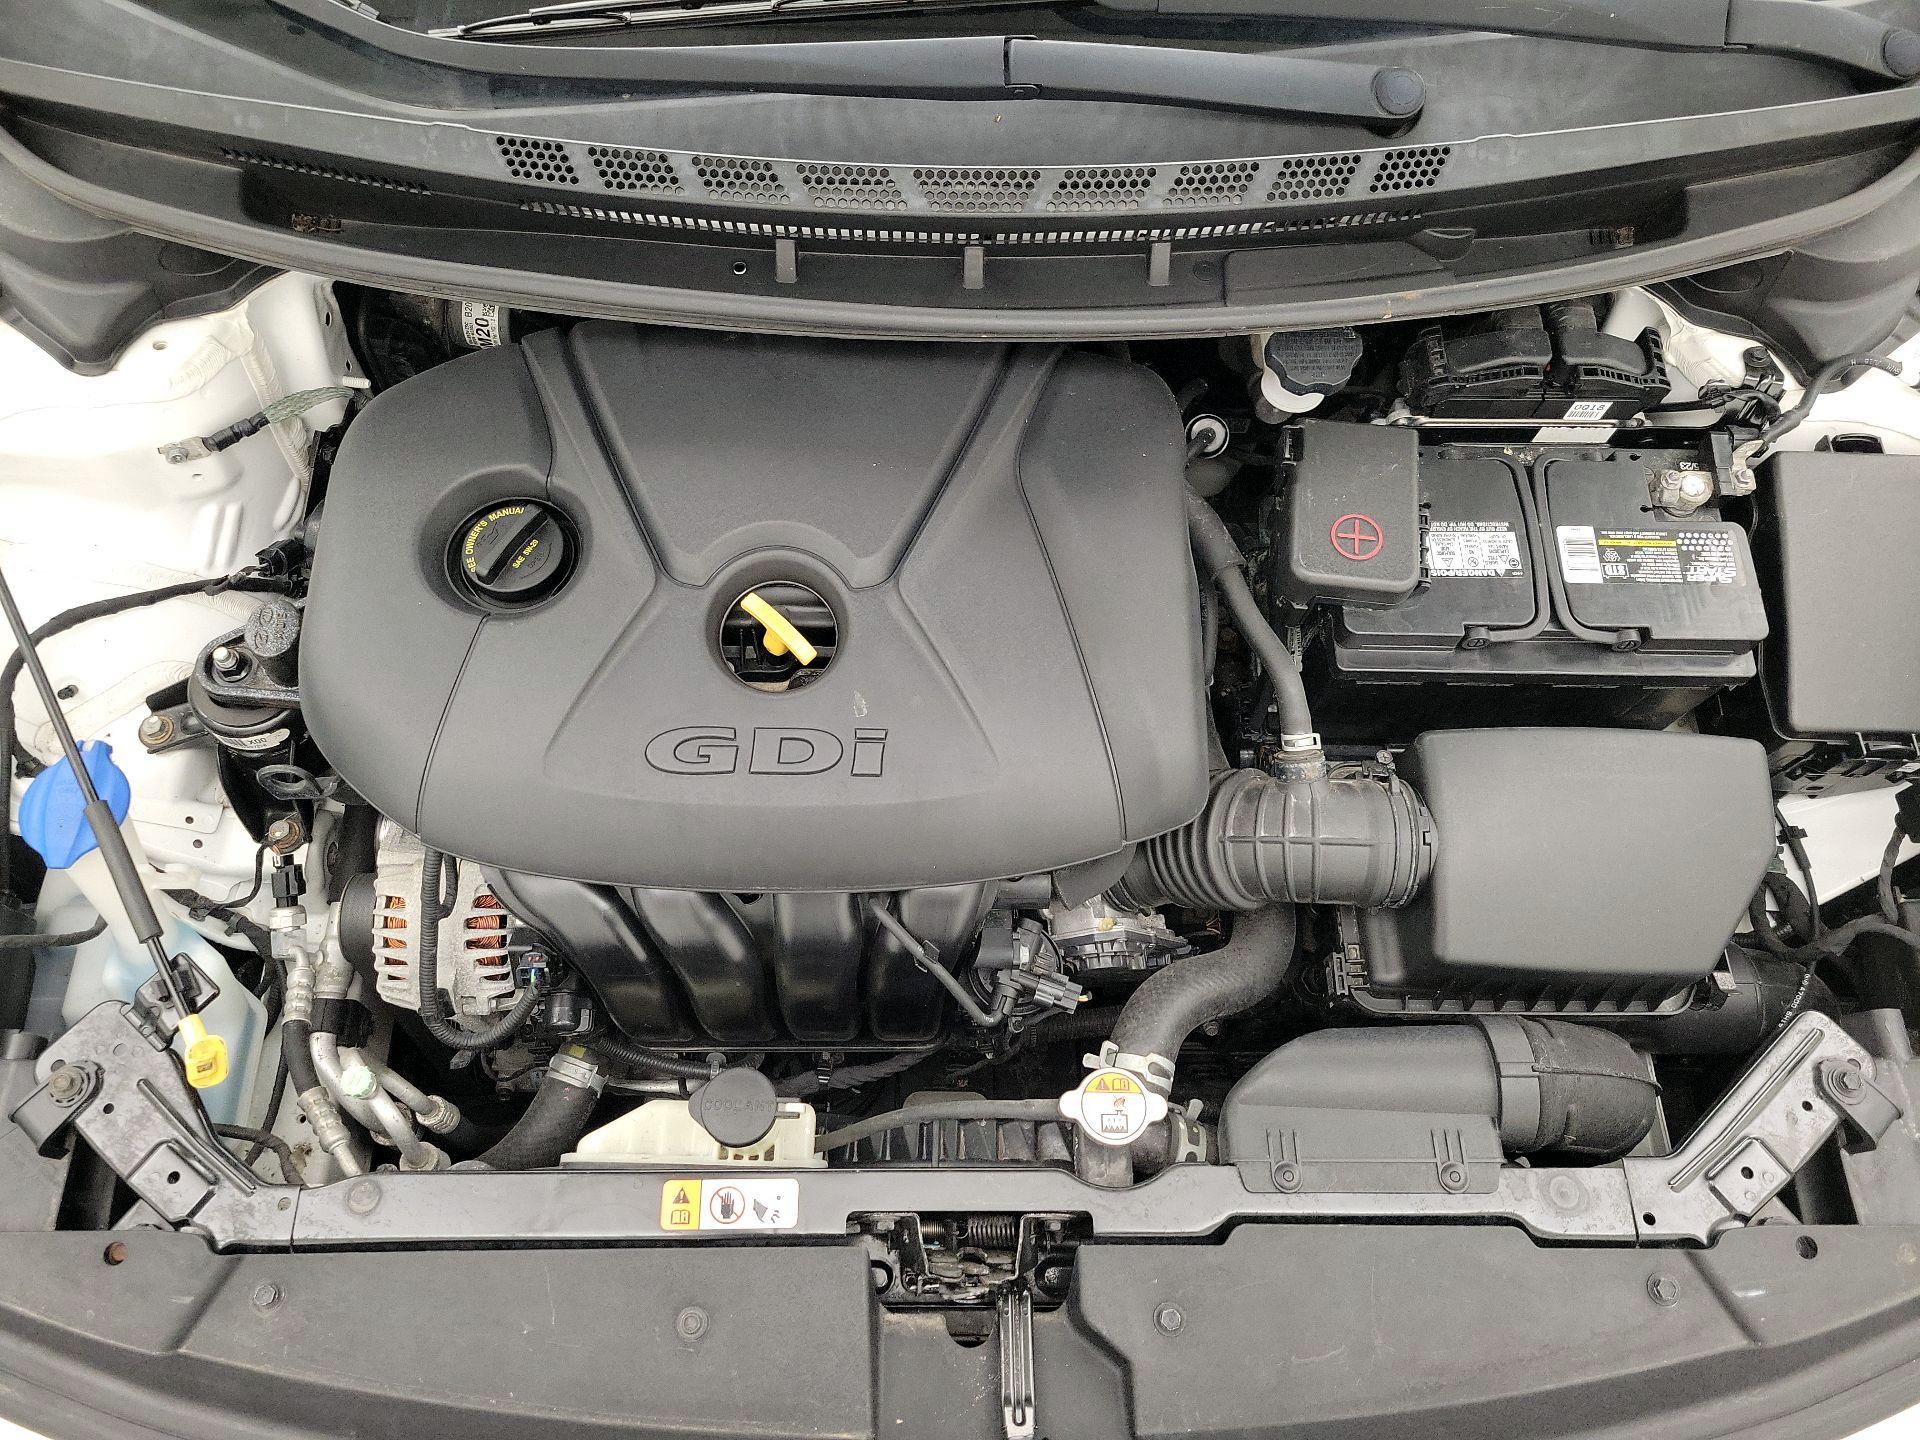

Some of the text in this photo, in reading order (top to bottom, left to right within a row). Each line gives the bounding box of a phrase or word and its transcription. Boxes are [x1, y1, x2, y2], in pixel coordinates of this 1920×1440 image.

[465, 519, 489, 555] OWNER'S
[512, 555, 526, 569] SAE
[522, 539, 539, 556] 5W-20
[1682, 566, 1737, 577] START
[645, 725, 888, 777] GDi
[704, 1098, 776, 1112] COOLANT
